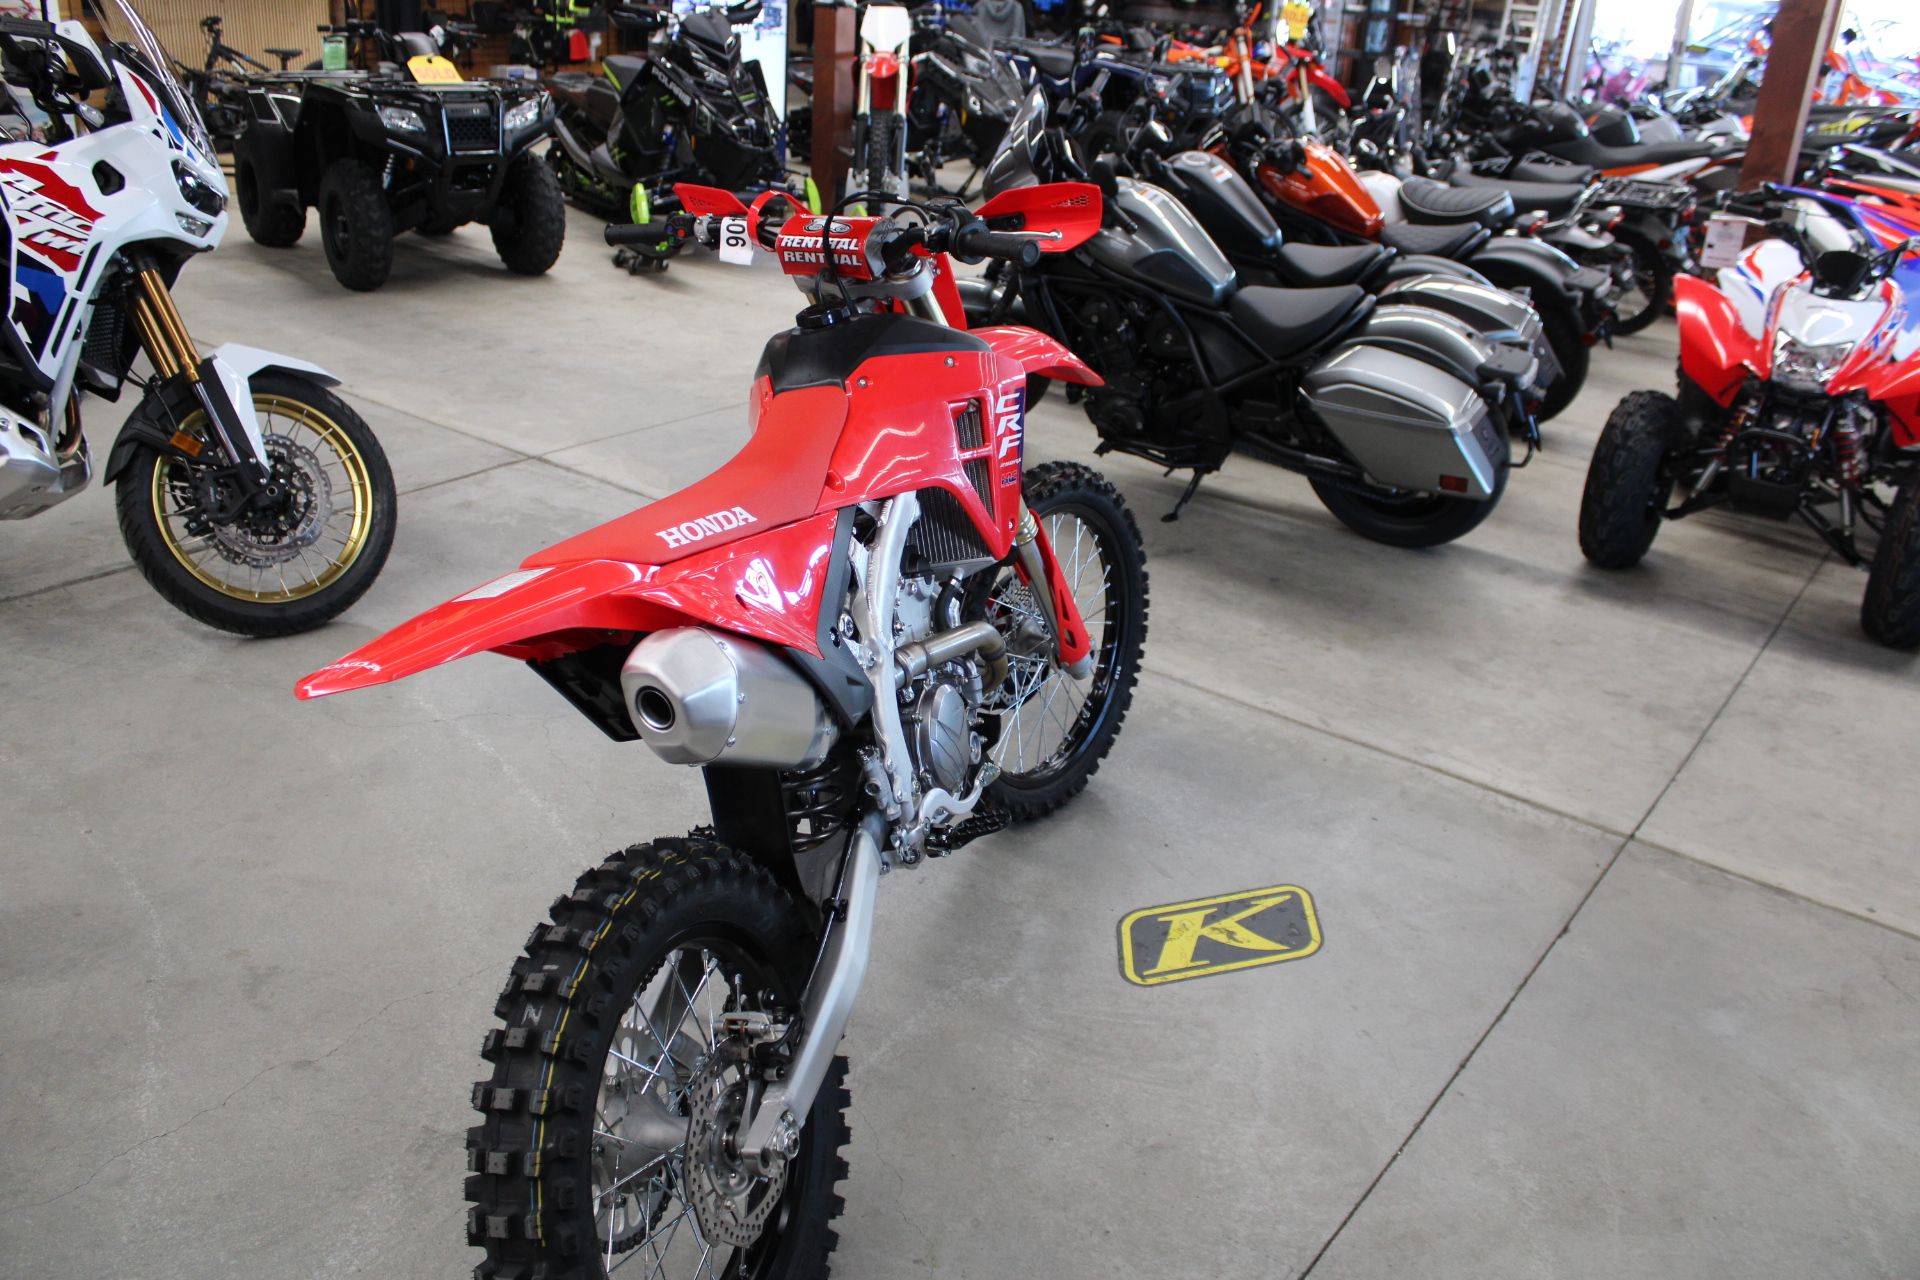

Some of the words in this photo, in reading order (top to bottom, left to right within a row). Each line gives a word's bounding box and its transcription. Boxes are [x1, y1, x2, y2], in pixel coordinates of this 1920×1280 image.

[415, 66, 457, 80] SOLD
[652, 65, 692, 107] POLARIS
[996, 393, 1022, 460] CRF
[655, 506, 758, 549] HONDA
